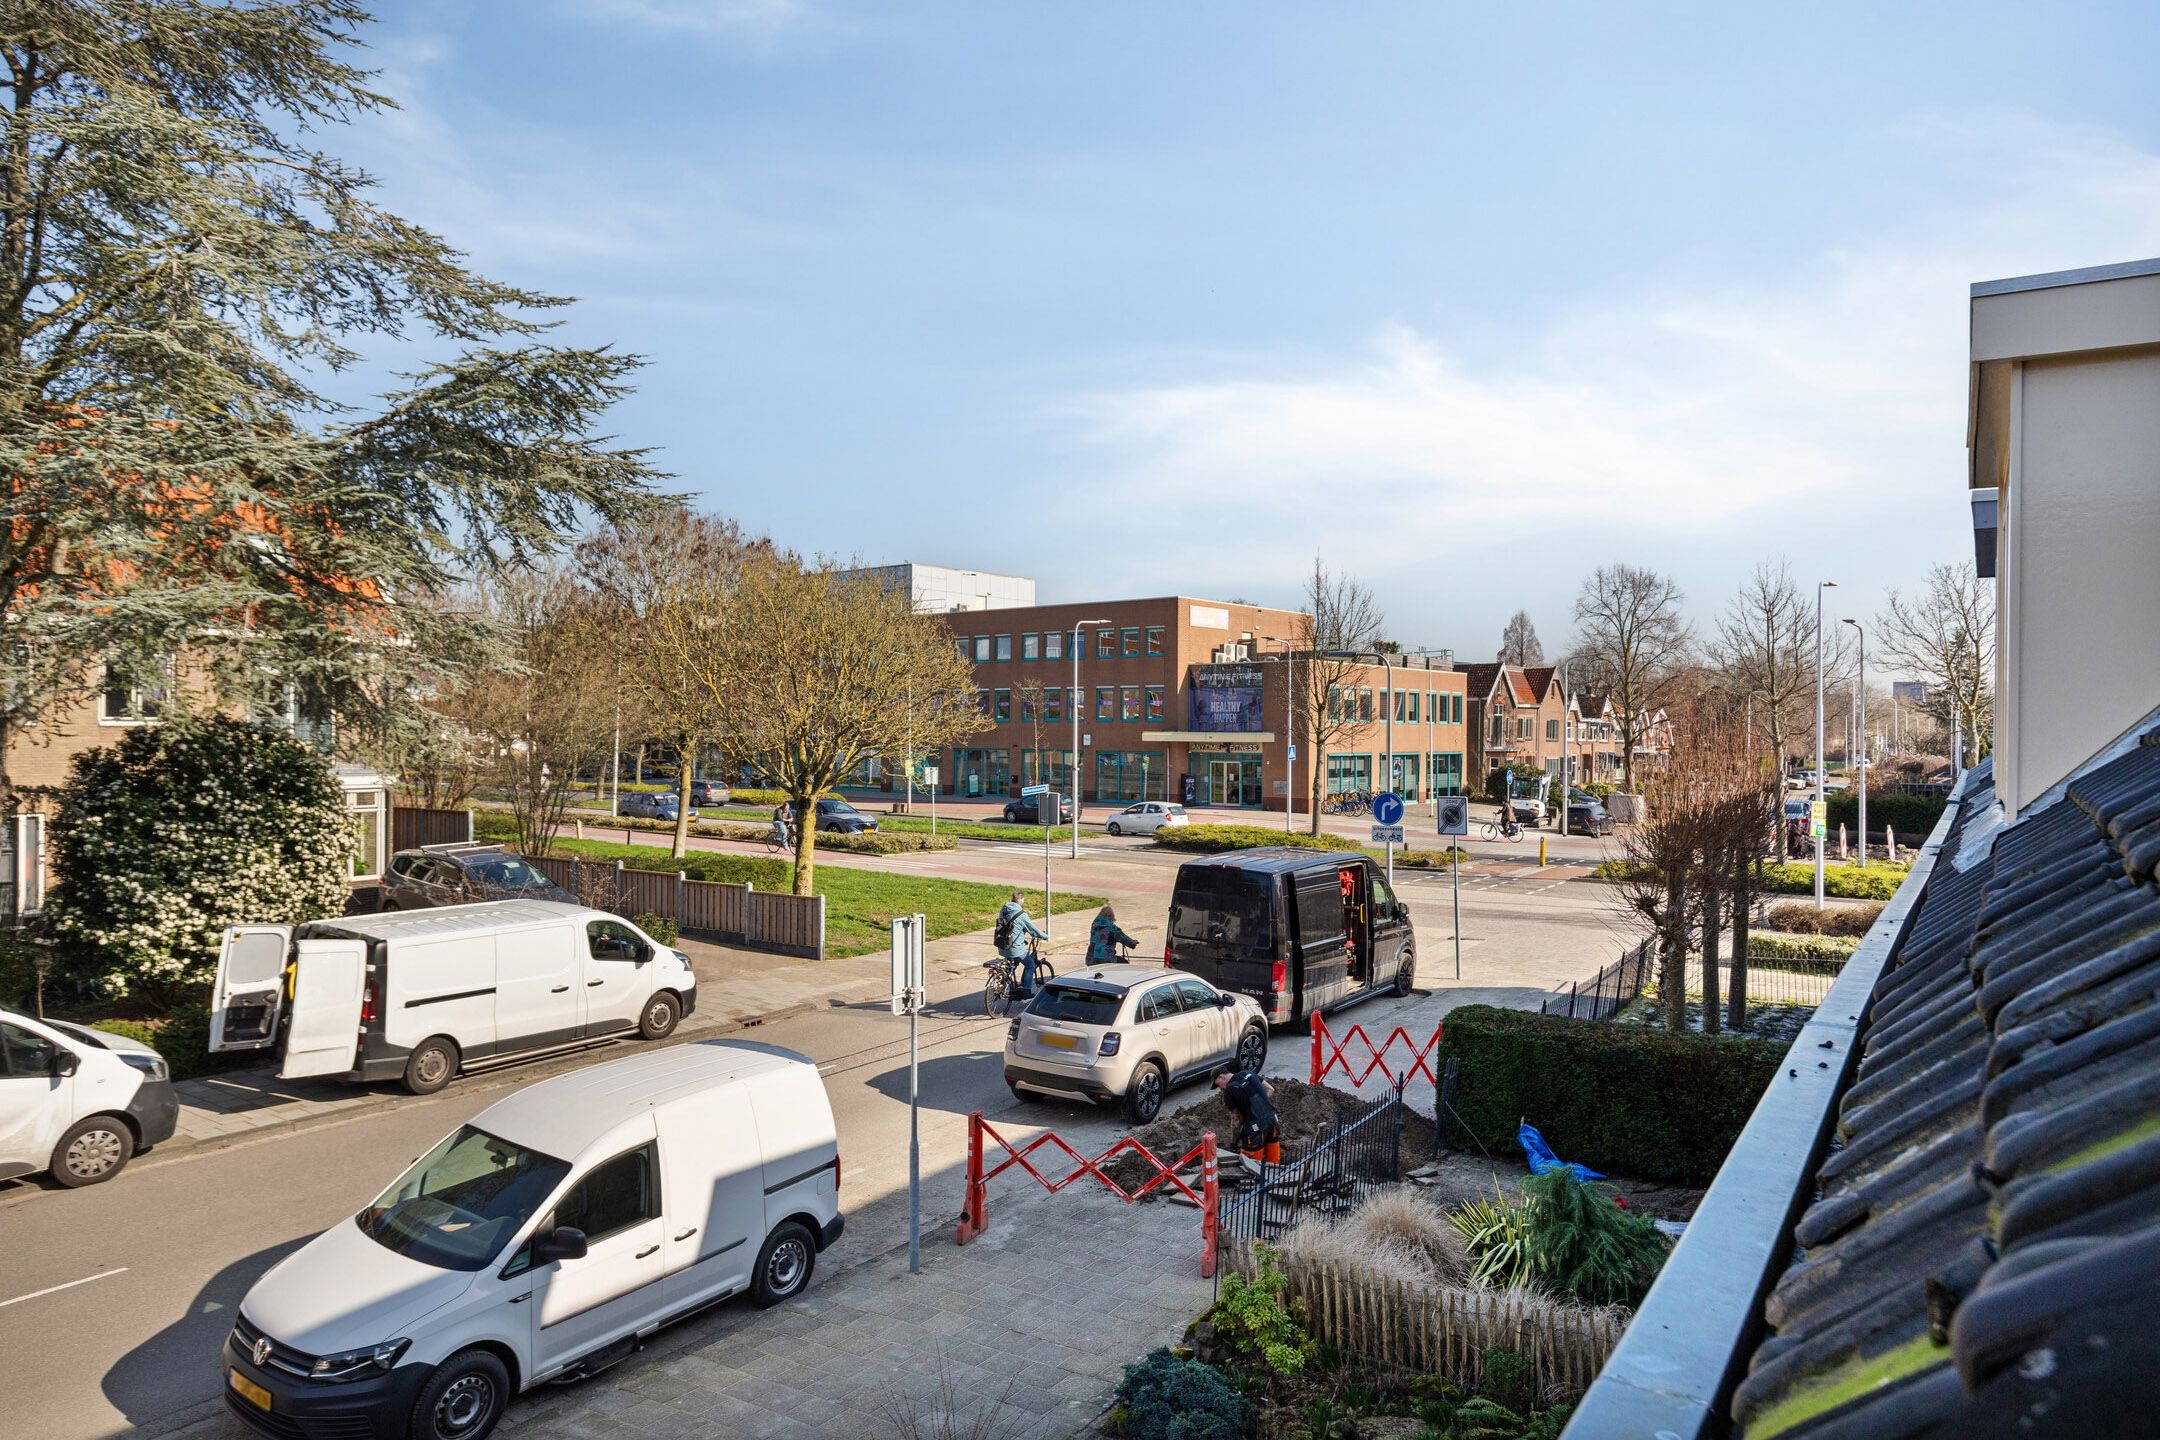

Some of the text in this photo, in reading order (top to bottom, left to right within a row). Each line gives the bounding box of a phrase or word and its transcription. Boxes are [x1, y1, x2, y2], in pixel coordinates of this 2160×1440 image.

[1199, 672, 1263, 681] ANYTIME FITNESS
[1210, 701, 1241, 712] HEALTHY
